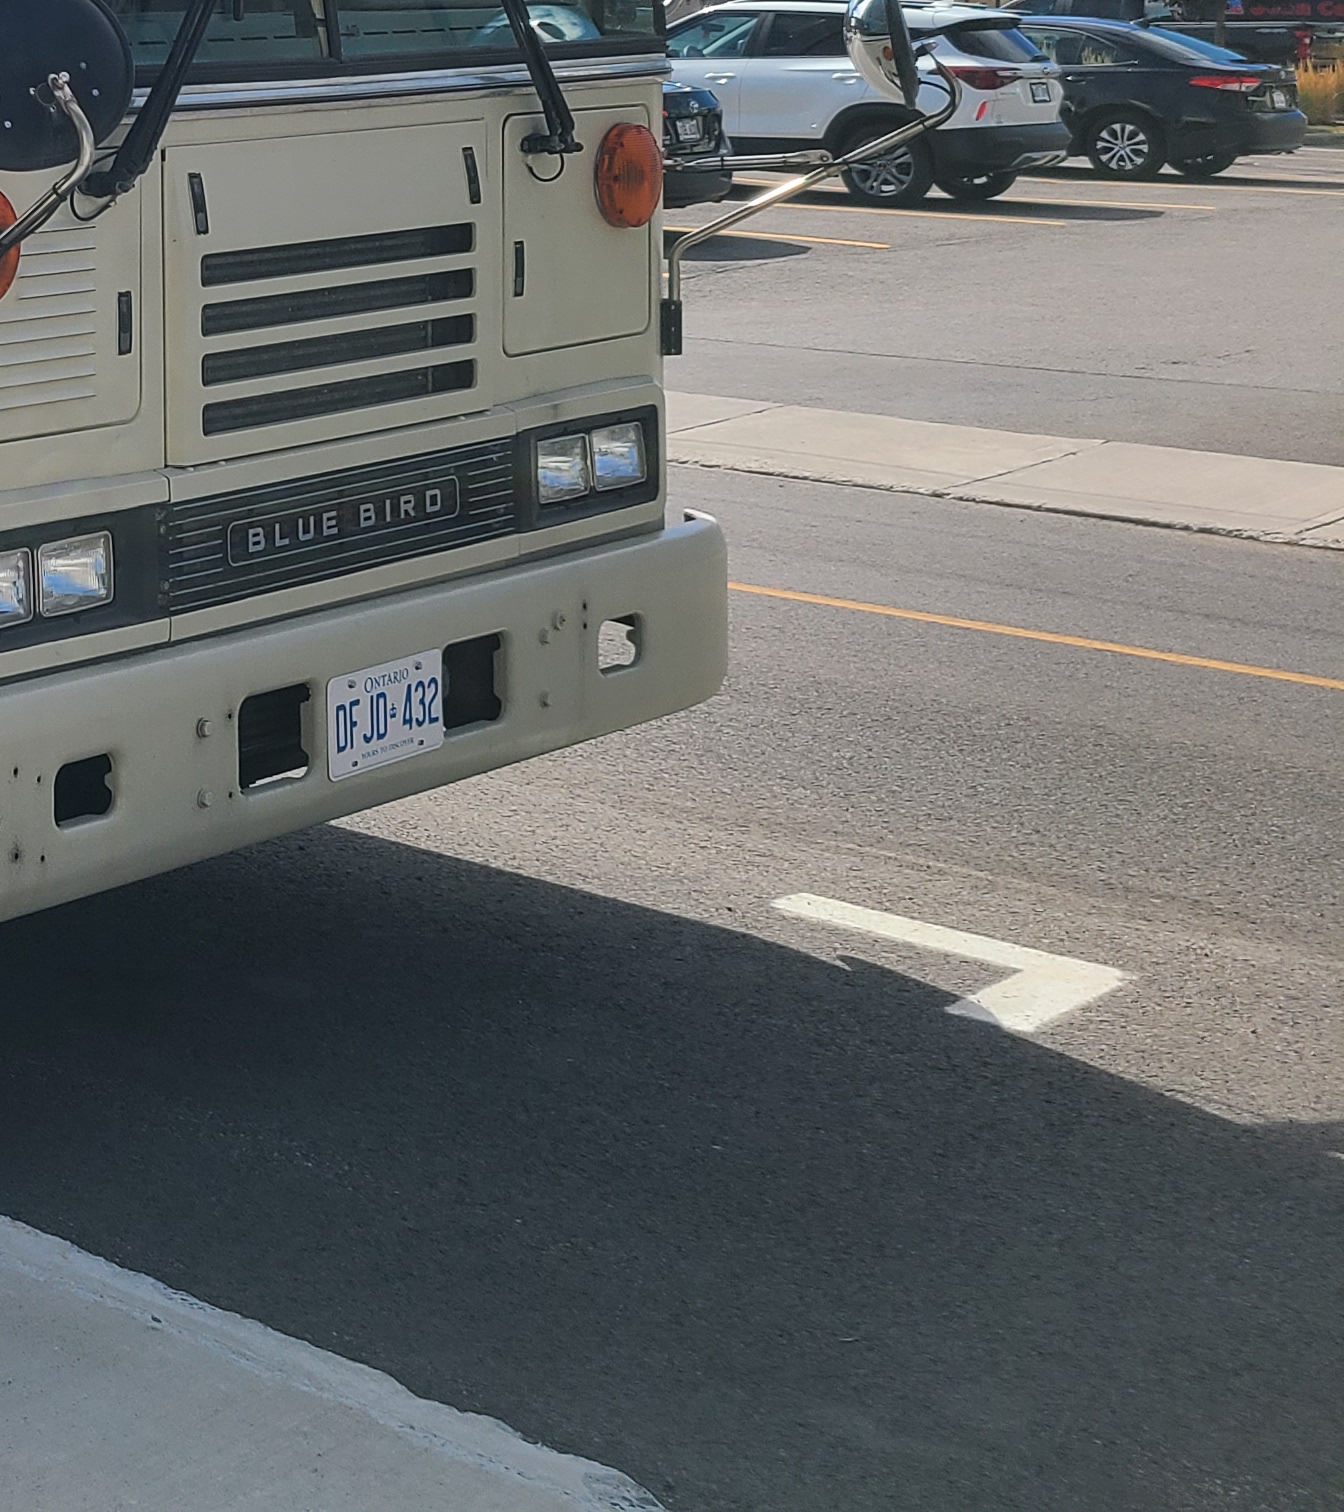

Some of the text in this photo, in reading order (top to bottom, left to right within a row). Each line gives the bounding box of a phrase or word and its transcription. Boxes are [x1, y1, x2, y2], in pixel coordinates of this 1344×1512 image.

[247, 488, 442, 554] BLUE BIRD
[402, 676, 440, 731] 432
